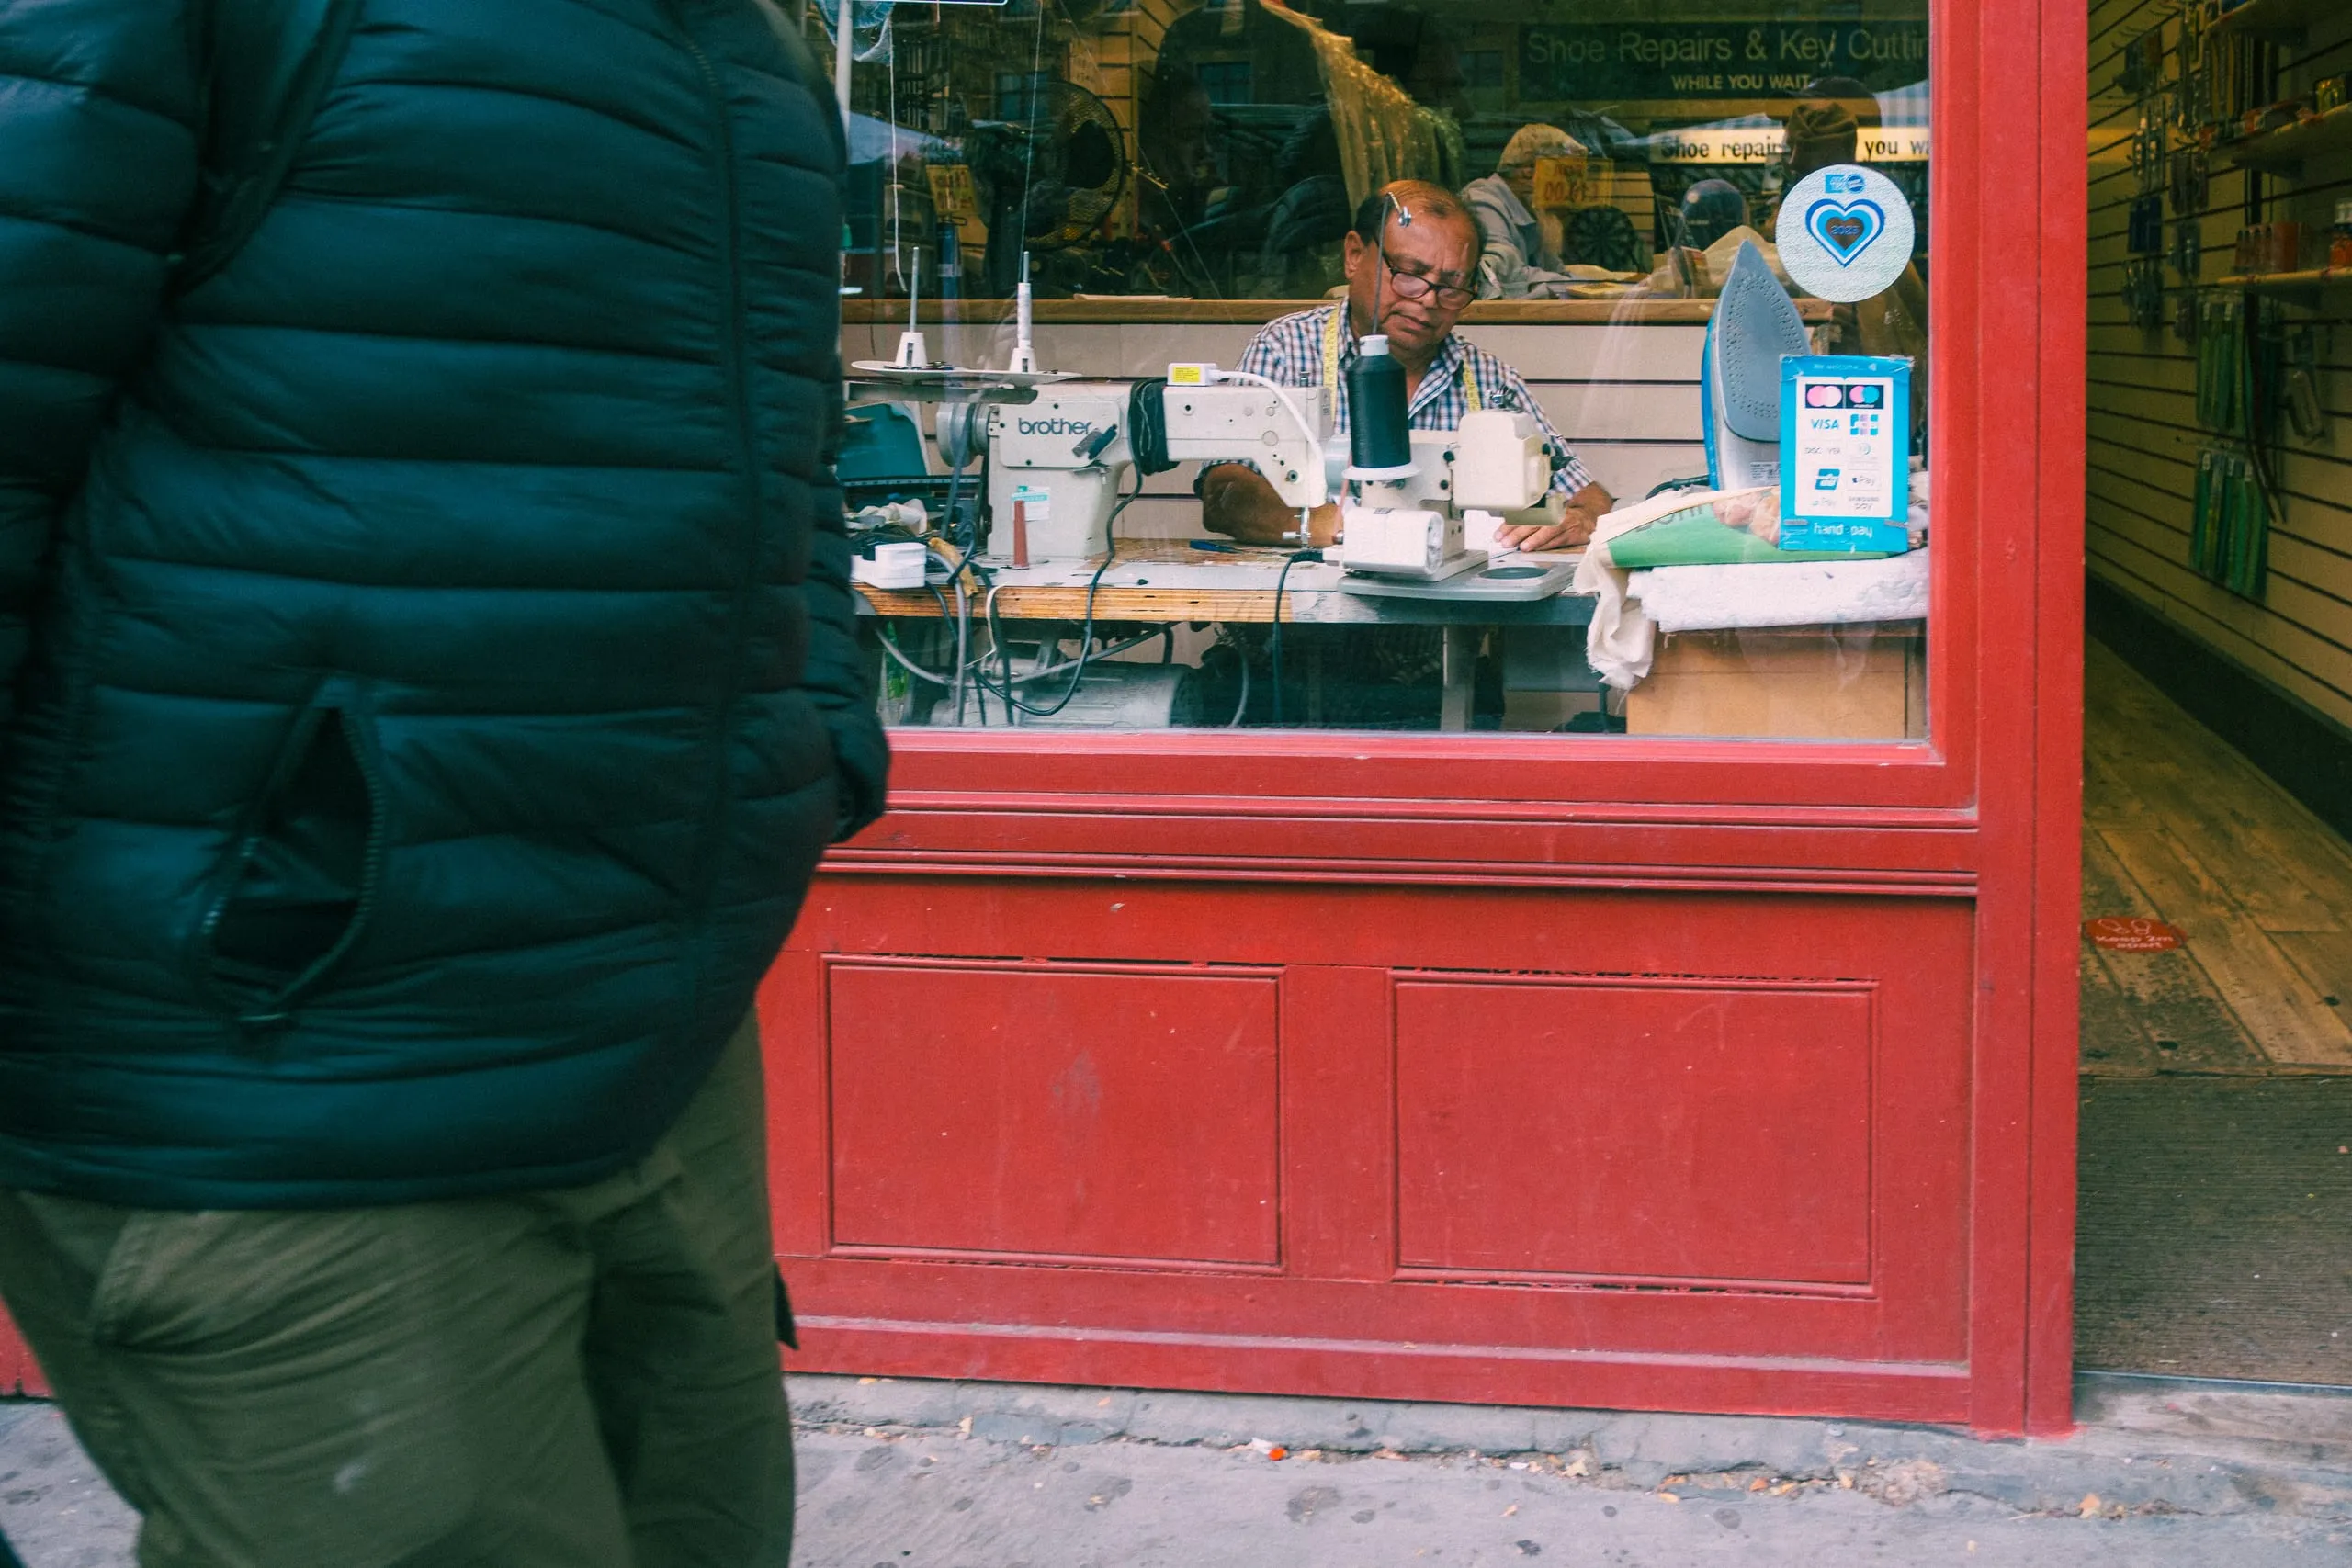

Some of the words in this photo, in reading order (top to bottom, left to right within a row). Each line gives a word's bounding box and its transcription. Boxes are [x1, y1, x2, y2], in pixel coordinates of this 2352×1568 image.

[1528, 31, 1606, 63] Shoe
[1619, 30, 1732, 69] Repairs
[1745, 28, 1769, 62] &
[1780, 29, 1838, 68] Key
[1671, 74, 1723, 90] WHILE
[1728, 74, 1763, 89] YOU
[1770, 73, 1812, 89] WAIT
[1865, 140, 1898, 161] you
[1018, 417, 1093, 435] brother
[1811, 418, 1840, 430] VISA
